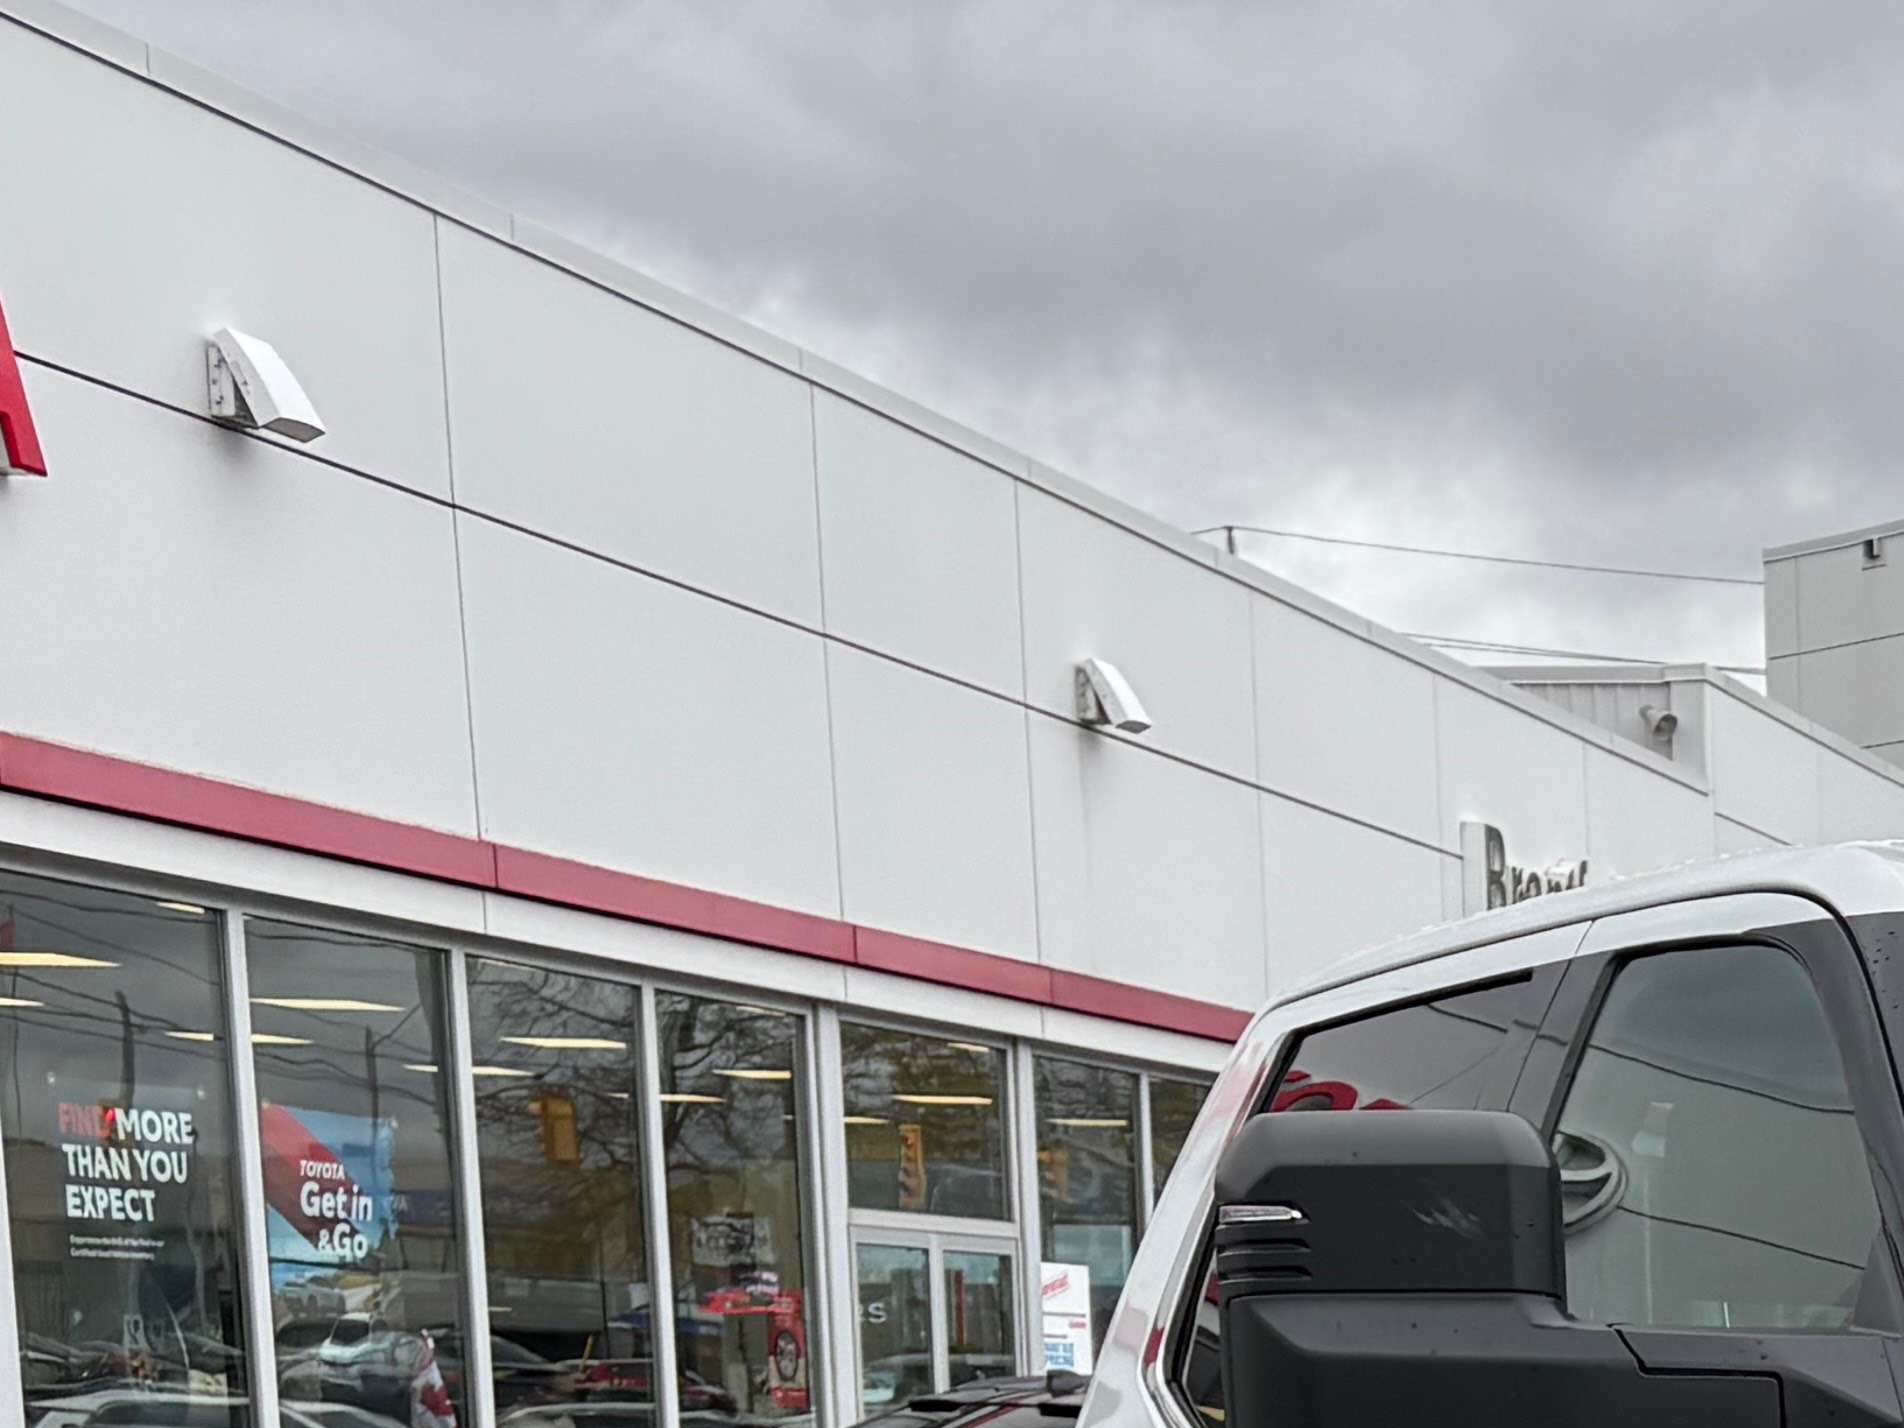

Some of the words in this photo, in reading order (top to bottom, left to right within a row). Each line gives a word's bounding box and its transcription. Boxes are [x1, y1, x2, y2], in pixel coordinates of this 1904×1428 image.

[114, 1107, 193, 1145] MORE
[62, 1143, 131, 1181] THAN
[132, 1149, 187, 1184] YOU
[299, 1160, 345, 1180] TOYOTA
[65, 1184, 155, 1222] EXPECT
[300, 1181, 348, 1218] Get
[351, 1184, 373, 1222] in
